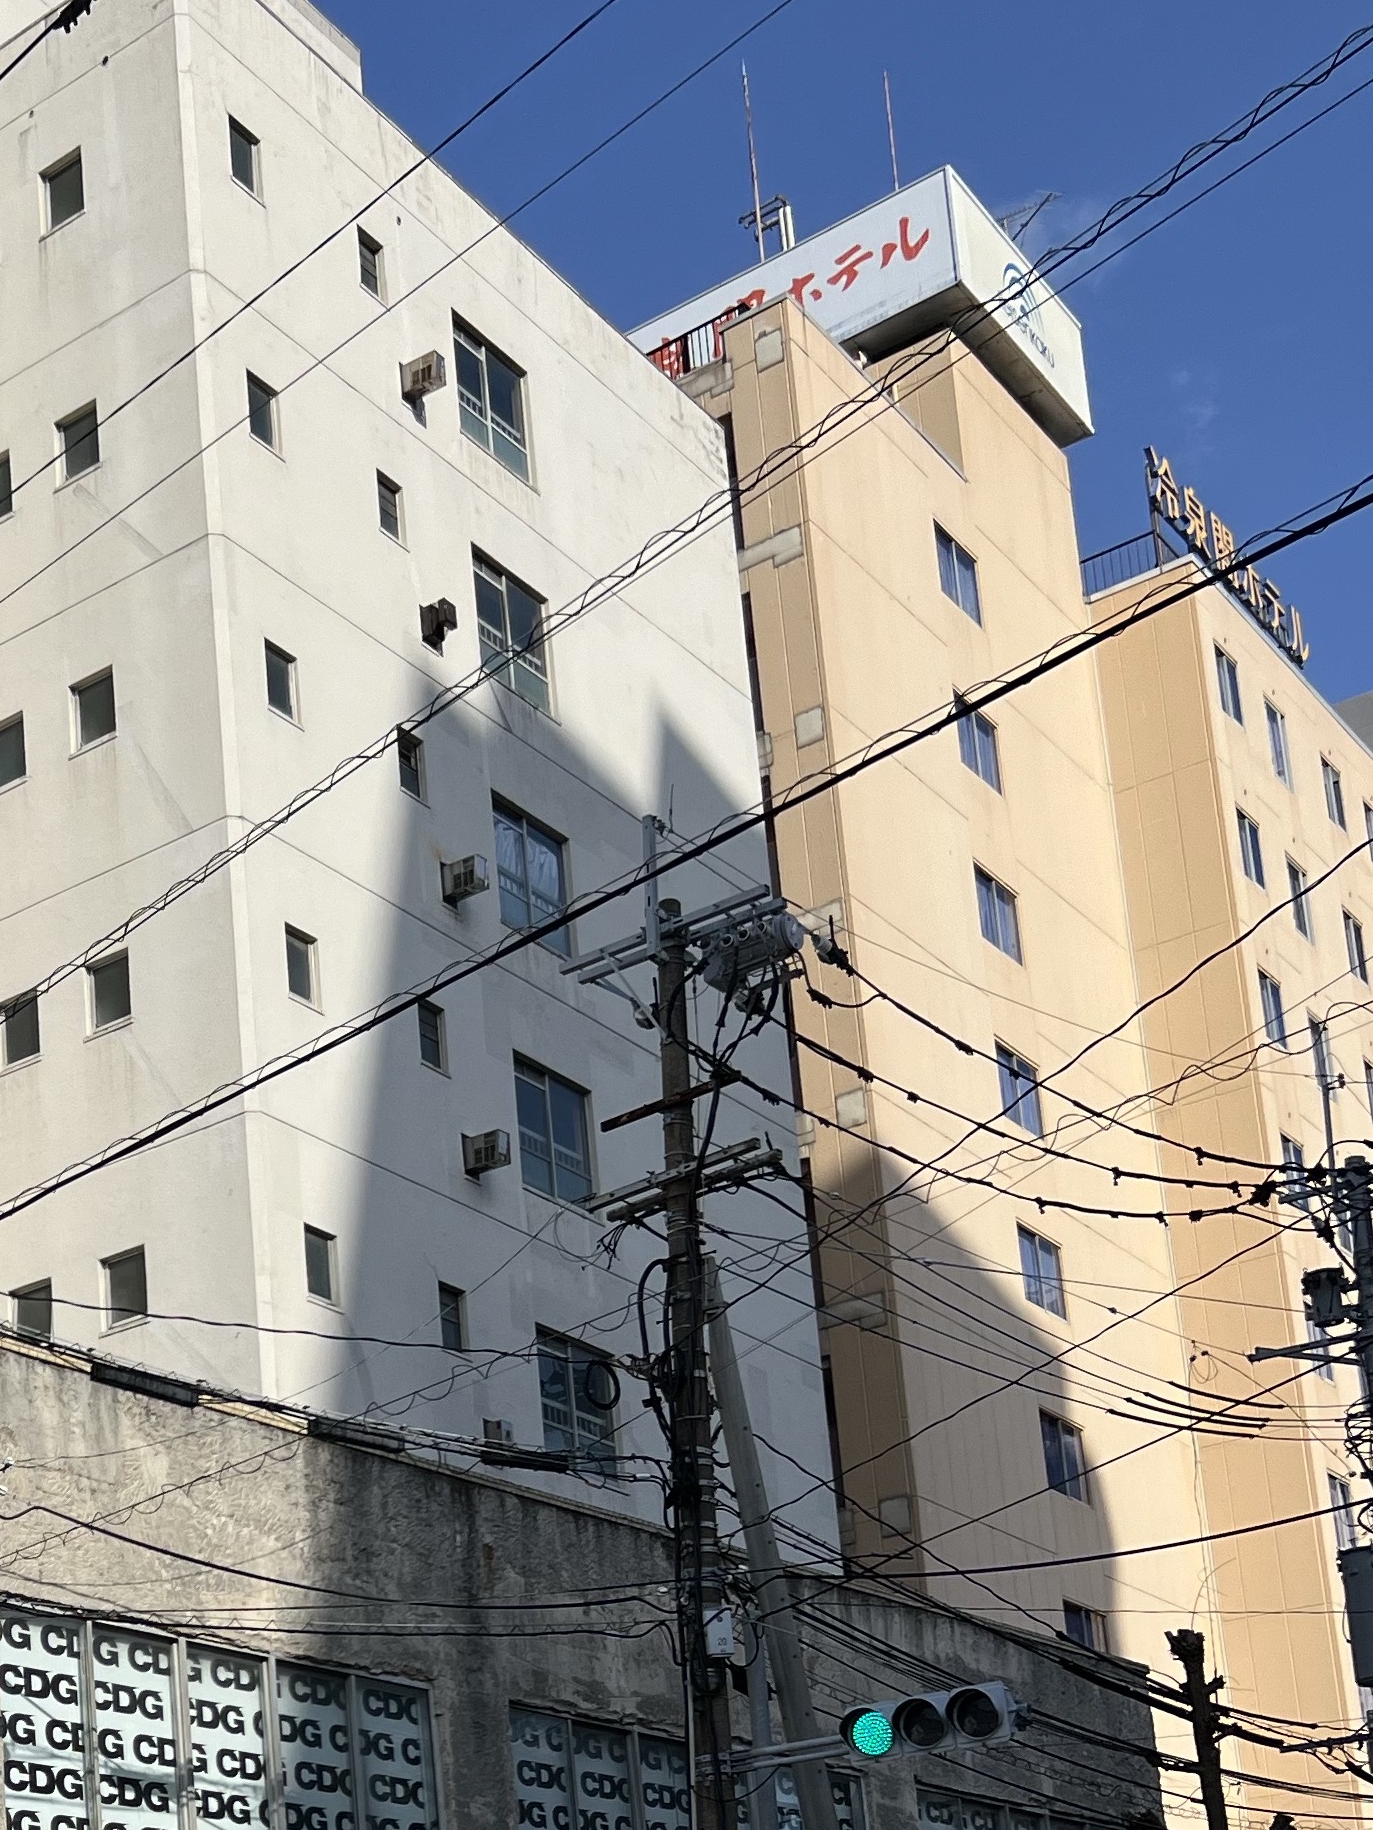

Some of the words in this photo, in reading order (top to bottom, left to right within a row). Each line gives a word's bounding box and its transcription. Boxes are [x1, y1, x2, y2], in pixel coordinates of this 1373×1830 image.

[210, 1657, 257, 1693] CD
[94, 1679, 164, 1721] CDG
[215, 1746, 264, 1782] CD
[3, 1758, 83, 1801] CDG
[98, 1773, 170, 1813] CDG
